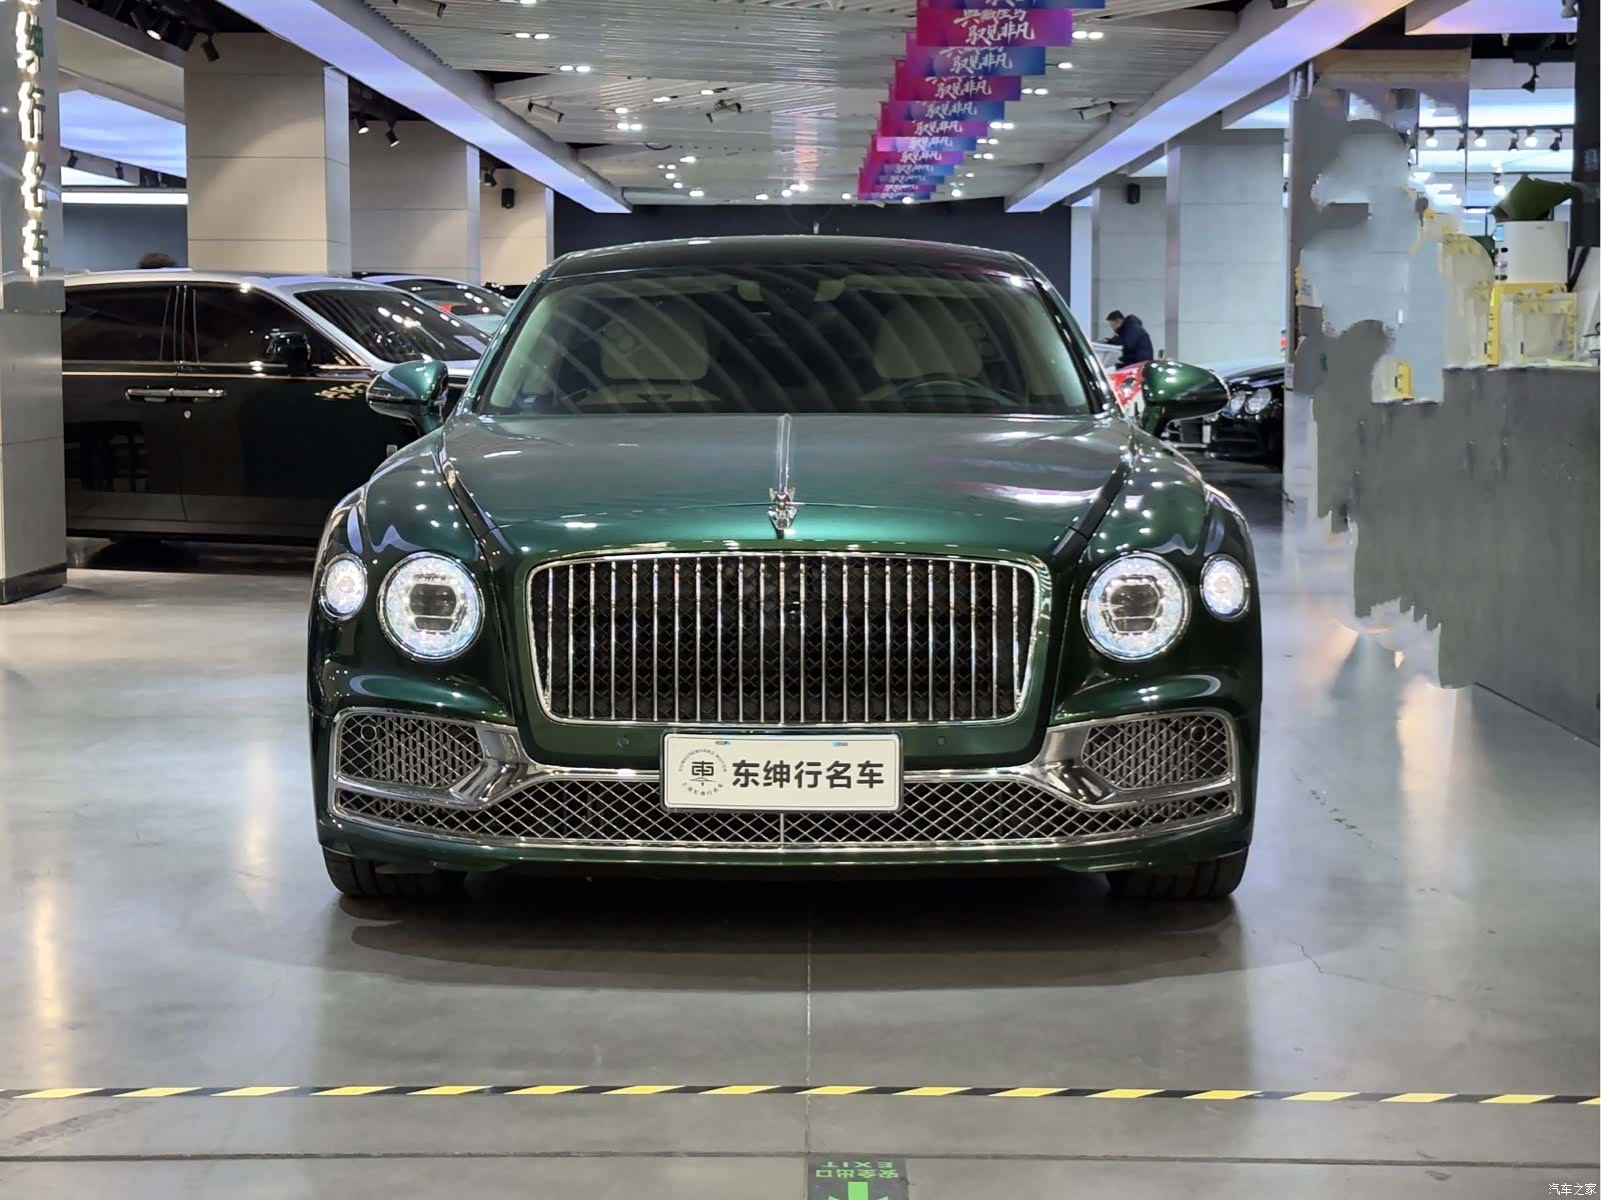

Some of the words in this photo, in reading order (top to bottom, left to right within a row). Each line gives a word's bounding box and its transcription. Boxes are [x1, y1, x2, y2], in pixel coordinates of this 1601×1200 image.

[965, 23, 1035, 46] 驭见非凡
[950, 53, 1013, 74] 驭见非凡
[934, 79, 992, 100] 驭见非凡
[731, 759, 885, 789] 东绅行名车
[815, 1169, 899, 1179] 安全出口
